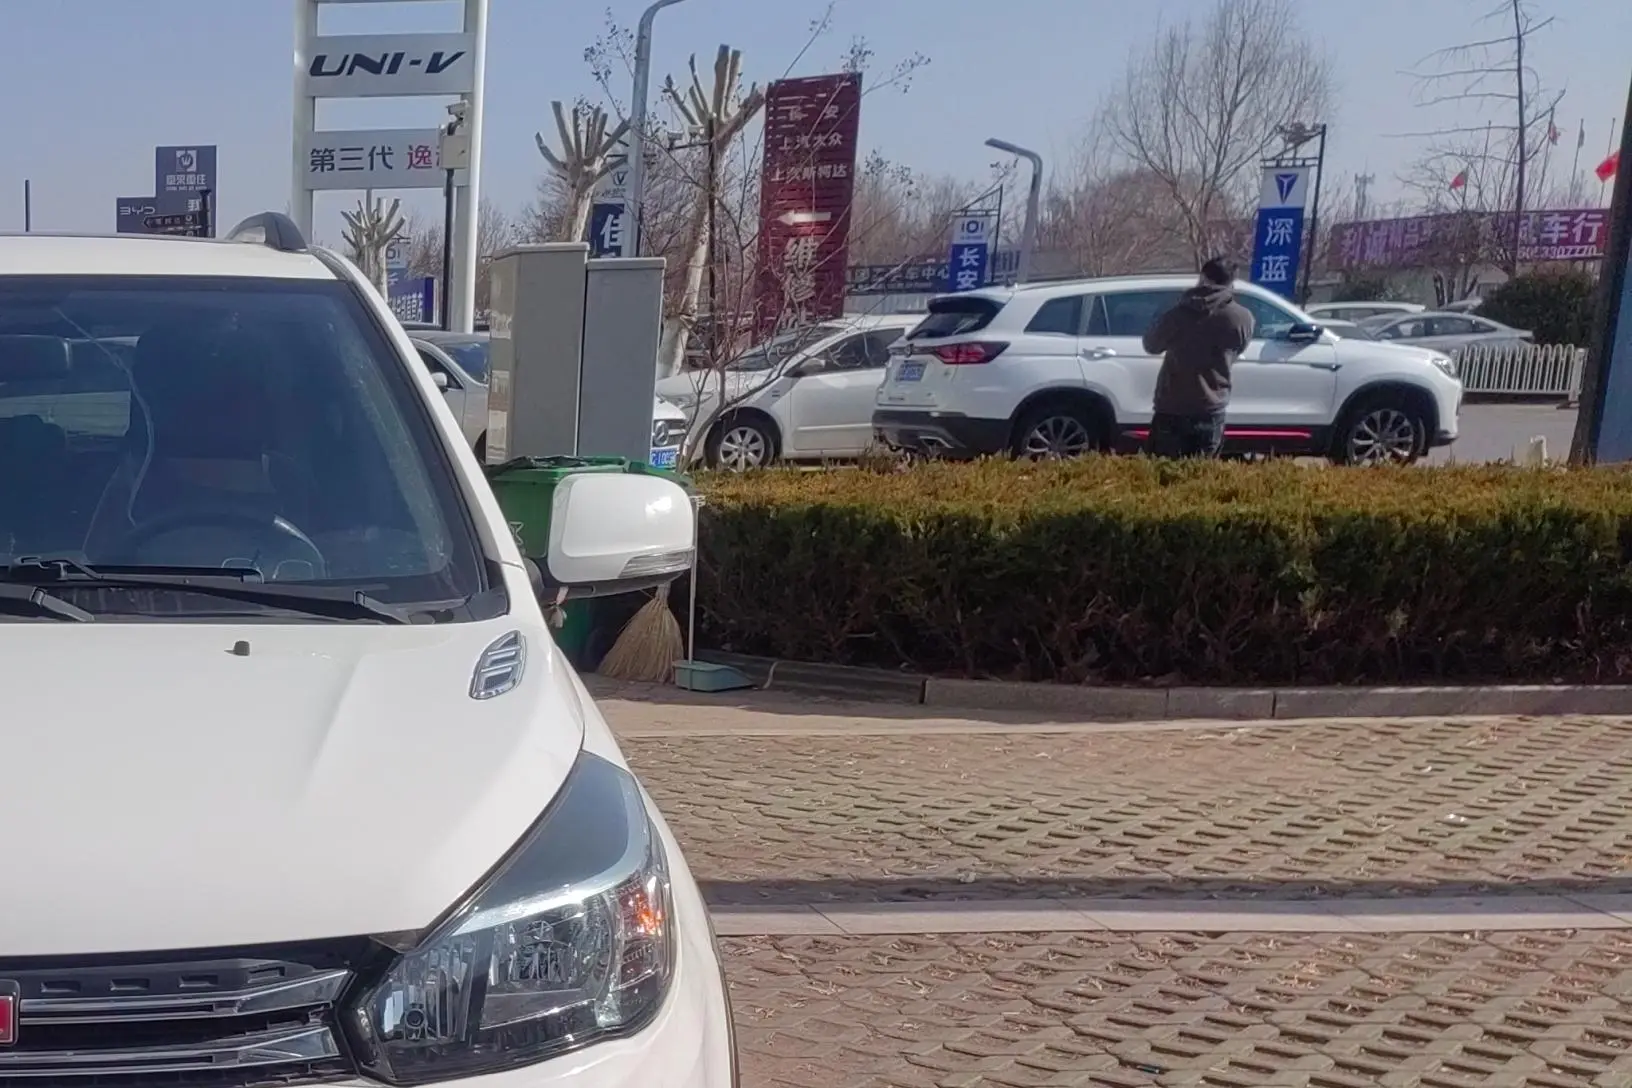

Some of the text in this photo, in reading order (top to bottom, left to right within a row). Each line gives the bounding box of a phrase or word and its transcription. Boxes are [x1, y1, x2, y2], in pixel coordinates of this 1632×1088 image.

[309, 52, 466, 77] UNI-V
[310, 145, 442, 172] 第三代 逸
[1260, 218, 1294, 282] 深蓝
[956, 247, 980, 289] 长安
